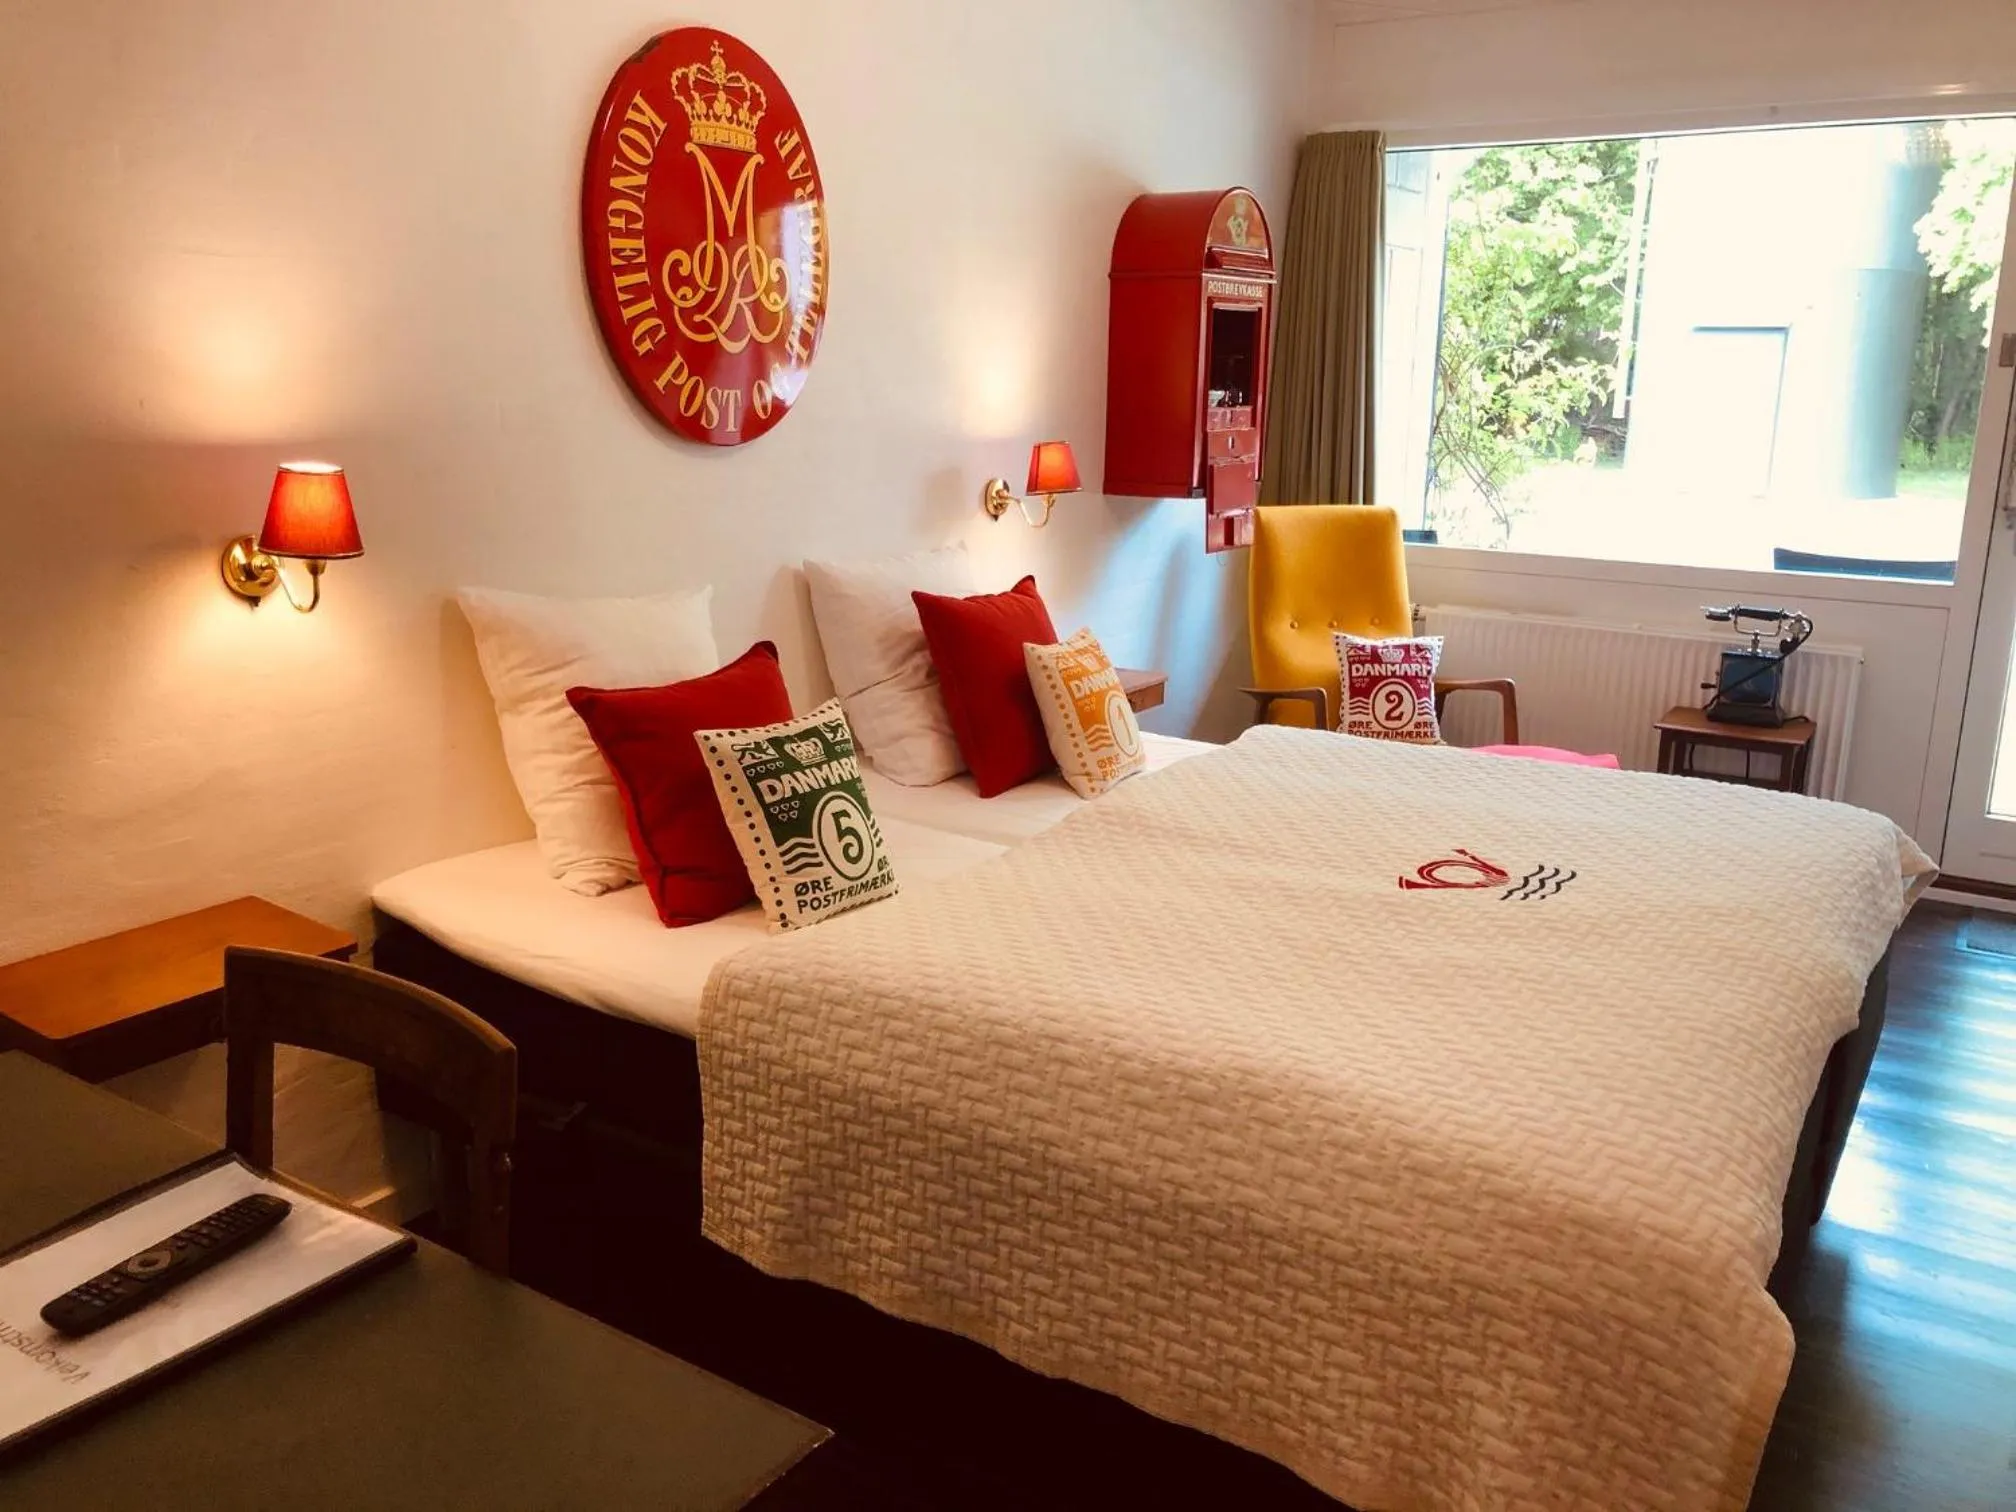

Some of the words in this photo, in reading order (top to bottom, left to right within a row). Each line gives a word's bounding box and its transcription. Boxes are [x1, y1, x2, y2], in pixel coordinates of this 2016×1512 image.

[607, 90, 668, 357] KONGELIG
[654, 350, 742, 433] POST
[1208, 280, 1263, 298] POSTBREVKASSE
[1385, 690, 1404, 722] 2
[832, 809, 864, 865] 5
[794, 876, 834, 898] ØRE
